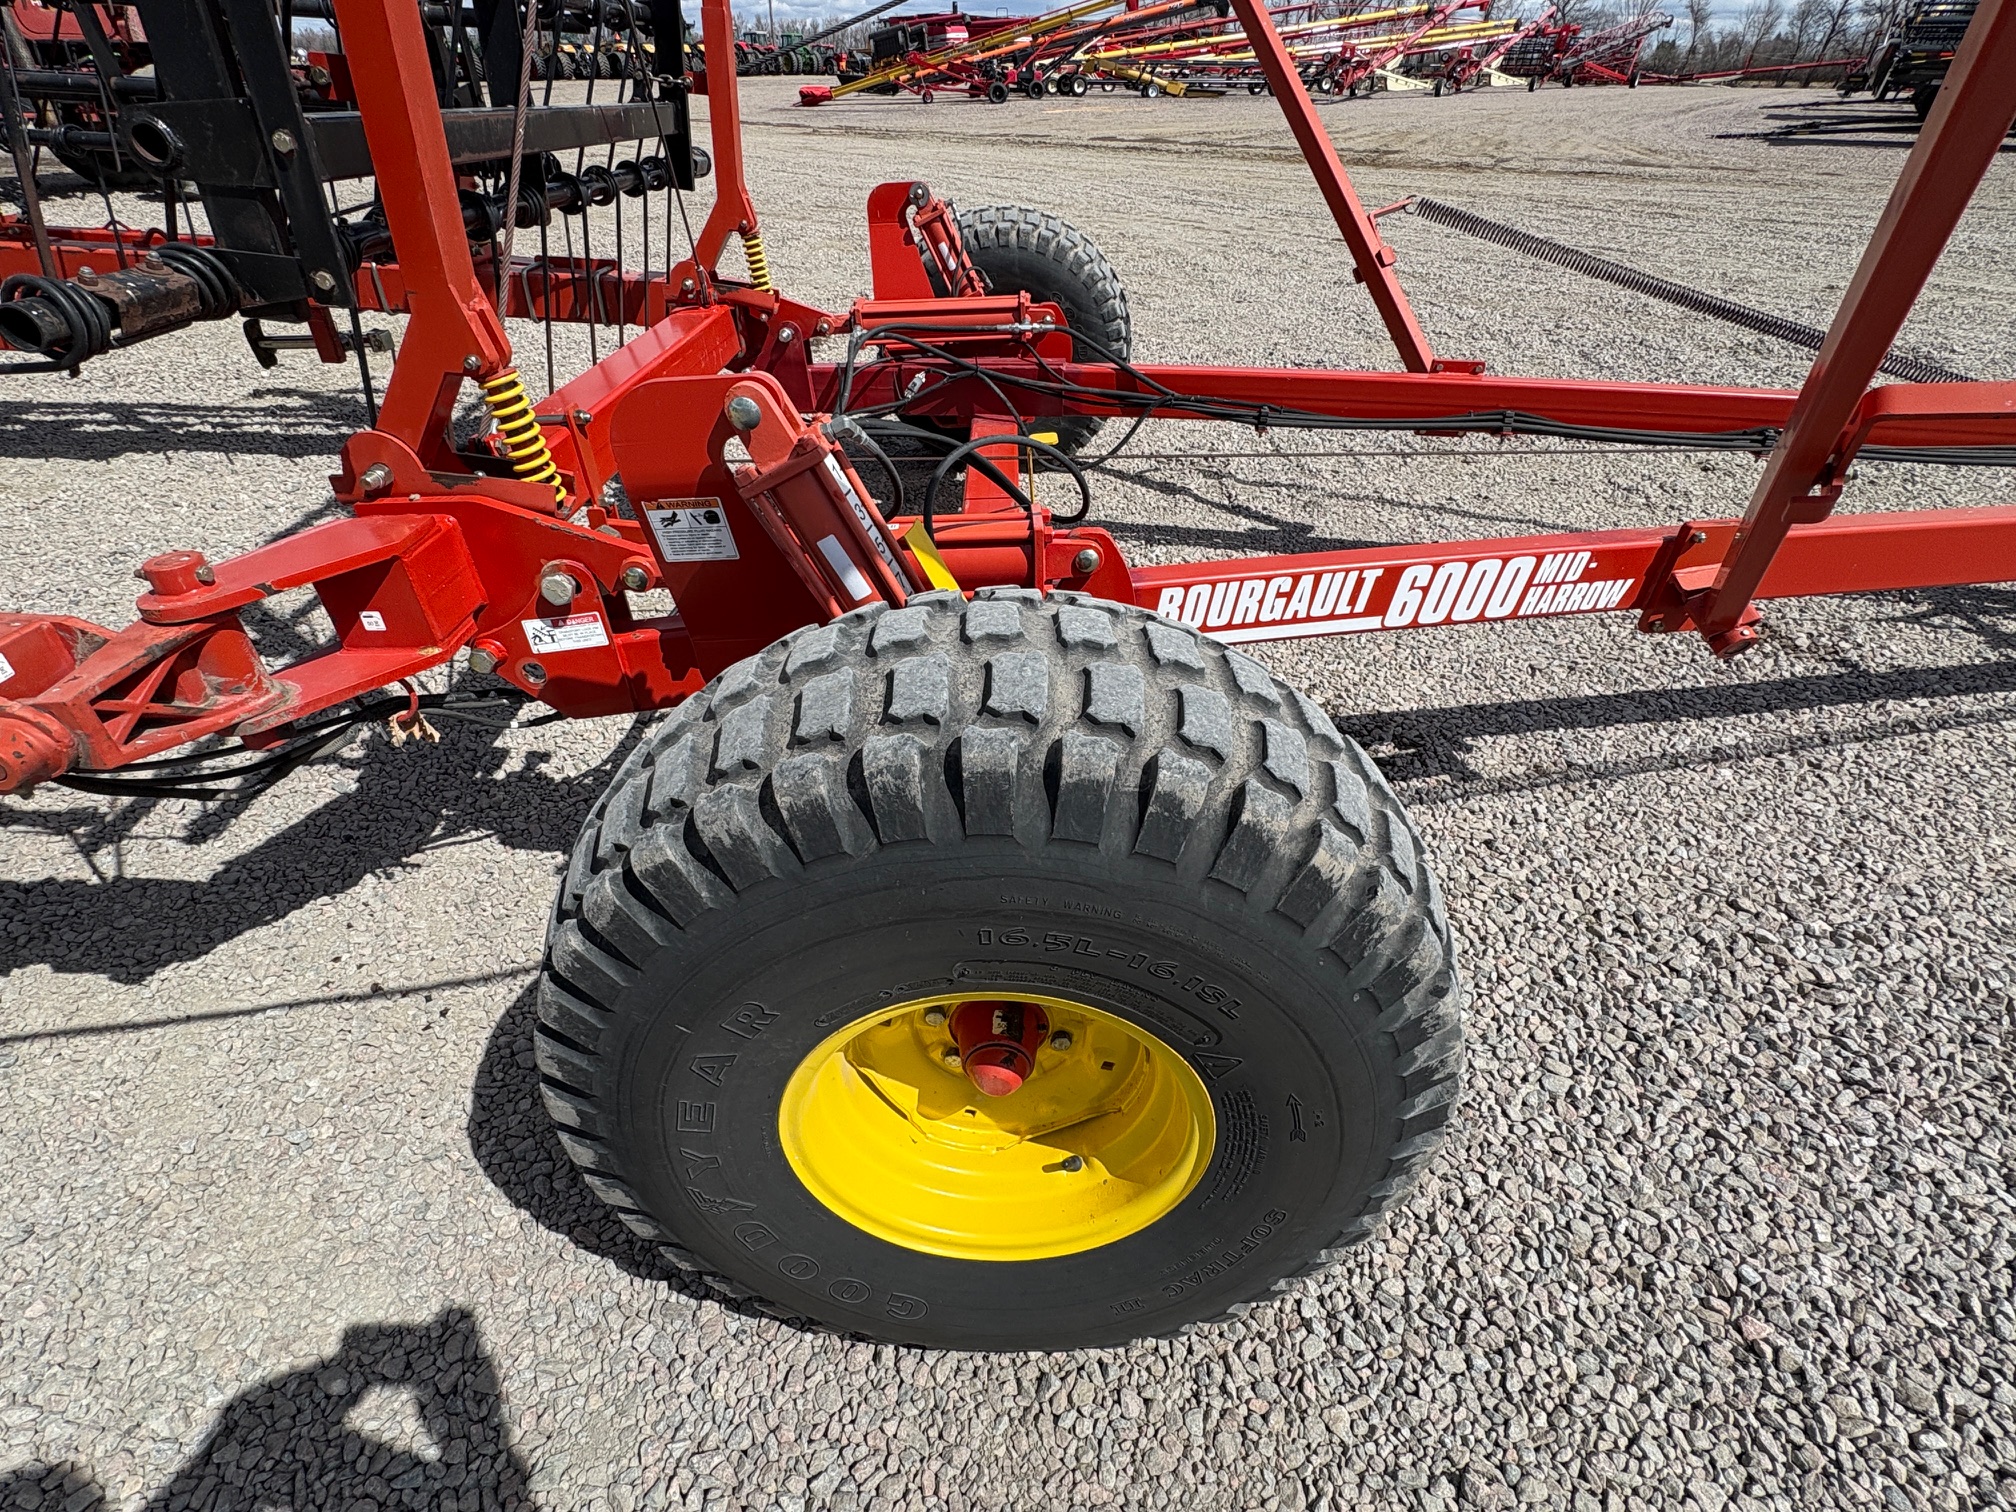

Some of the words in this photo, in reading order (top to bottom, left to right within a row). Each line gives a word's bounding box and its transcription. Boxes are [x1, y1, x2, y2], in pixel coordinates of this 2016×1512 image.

[666, 500, 712, 509] WARNING
[1535, 550, 1598, 584] MID-
[1156, 567, 1384, 629] BOURGAULT
[1382, 555, 1537, 628] 6000
[1517, 579, 1635, 616] HARROW
[566, 616, 595, 625] DANGER
[1000, 894, 1049, 907] SAFETY
[1063, 899, 1122, 919] WARNING
[977, 927, 1244, 1021] 16.5L-16.1SL
[676, 1001, 928, 1320] GOODYEAR
[1161, 1207, 1288, 1298] SOFTRAC
